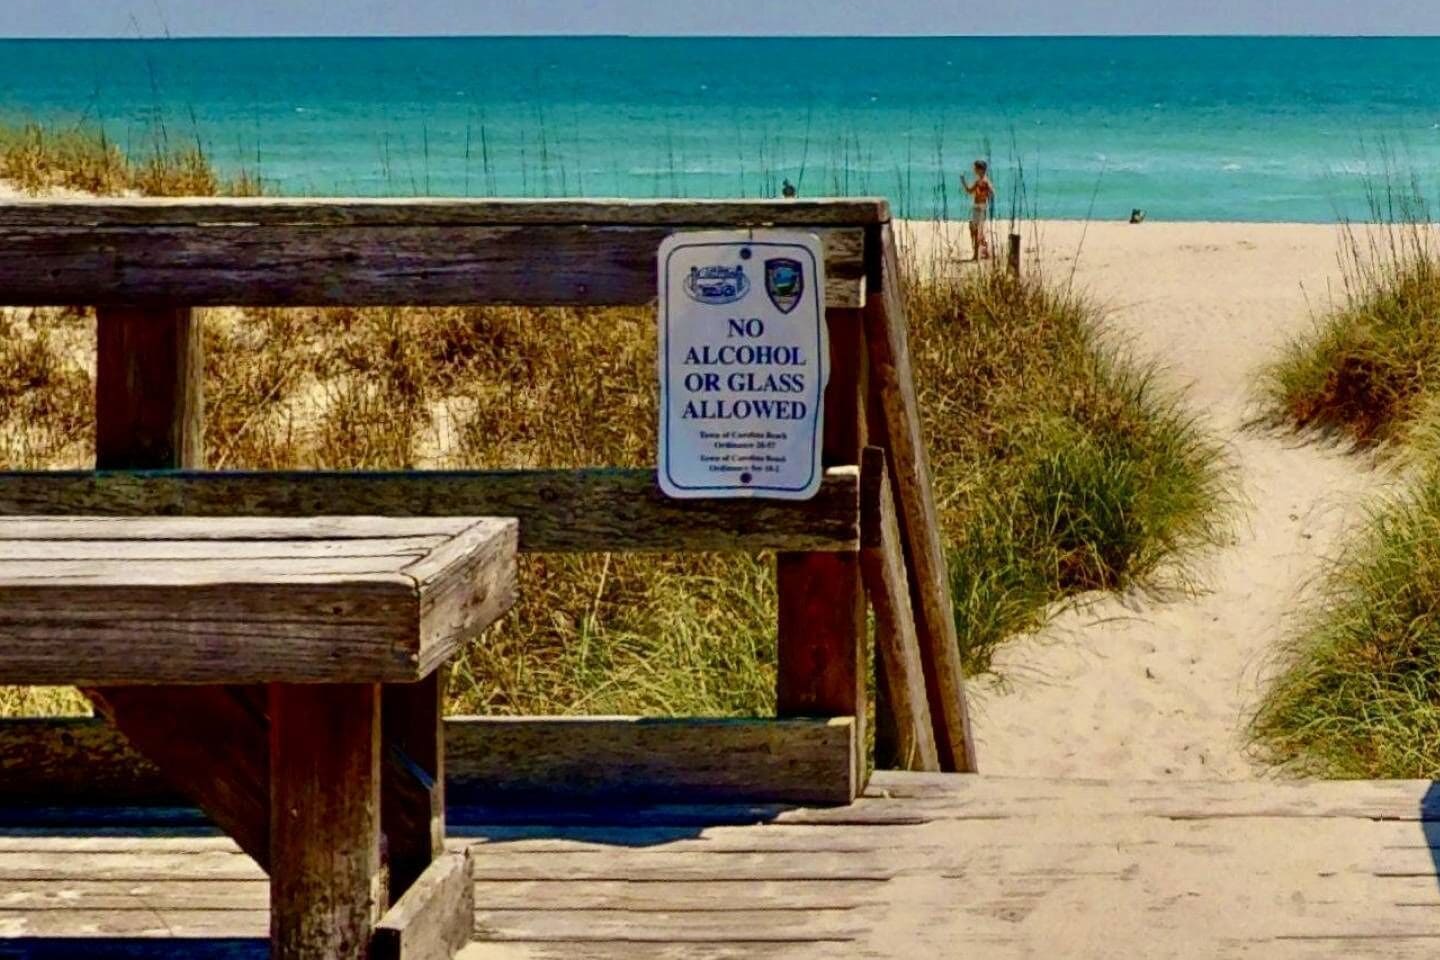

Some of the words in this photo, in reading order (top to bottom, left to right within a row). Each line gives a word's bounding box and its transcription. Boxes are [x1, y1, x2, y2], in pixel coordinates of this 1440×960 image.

[728, 318, 764, 338] NO
[683, 345, 807, 366] ALCOHOL
[684, 372, 721, 392] OR
[727, 372, 805, 393] GLASS
[681, 400, 807, 420] ALLOWED
